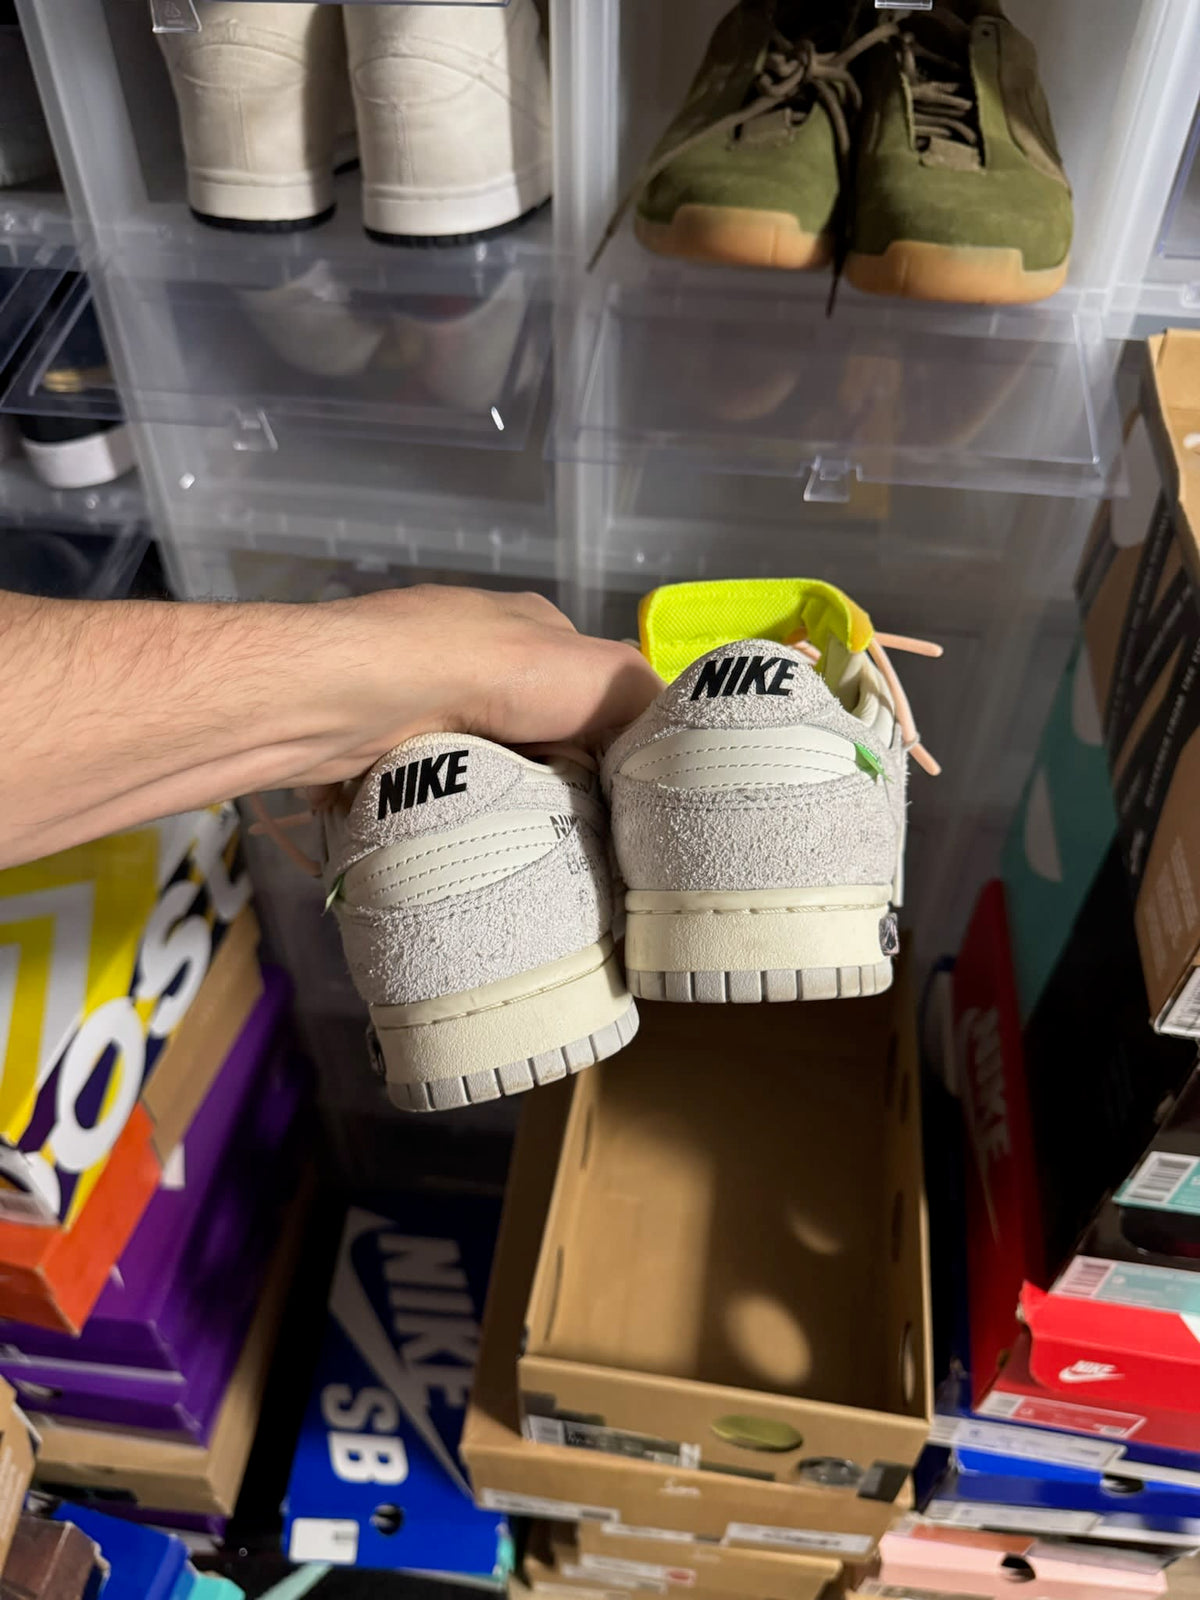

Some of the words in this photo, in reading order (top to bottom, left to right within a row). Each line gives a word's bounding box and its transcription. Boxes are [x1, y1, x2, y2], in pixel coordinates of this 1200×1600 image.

[690, 656, 799, 701] NIKE
[377, 749, 469, 820] NIKE
[376, 1232, 481, 1410] NIKE
[320, 1382, 410, 1486] SB
